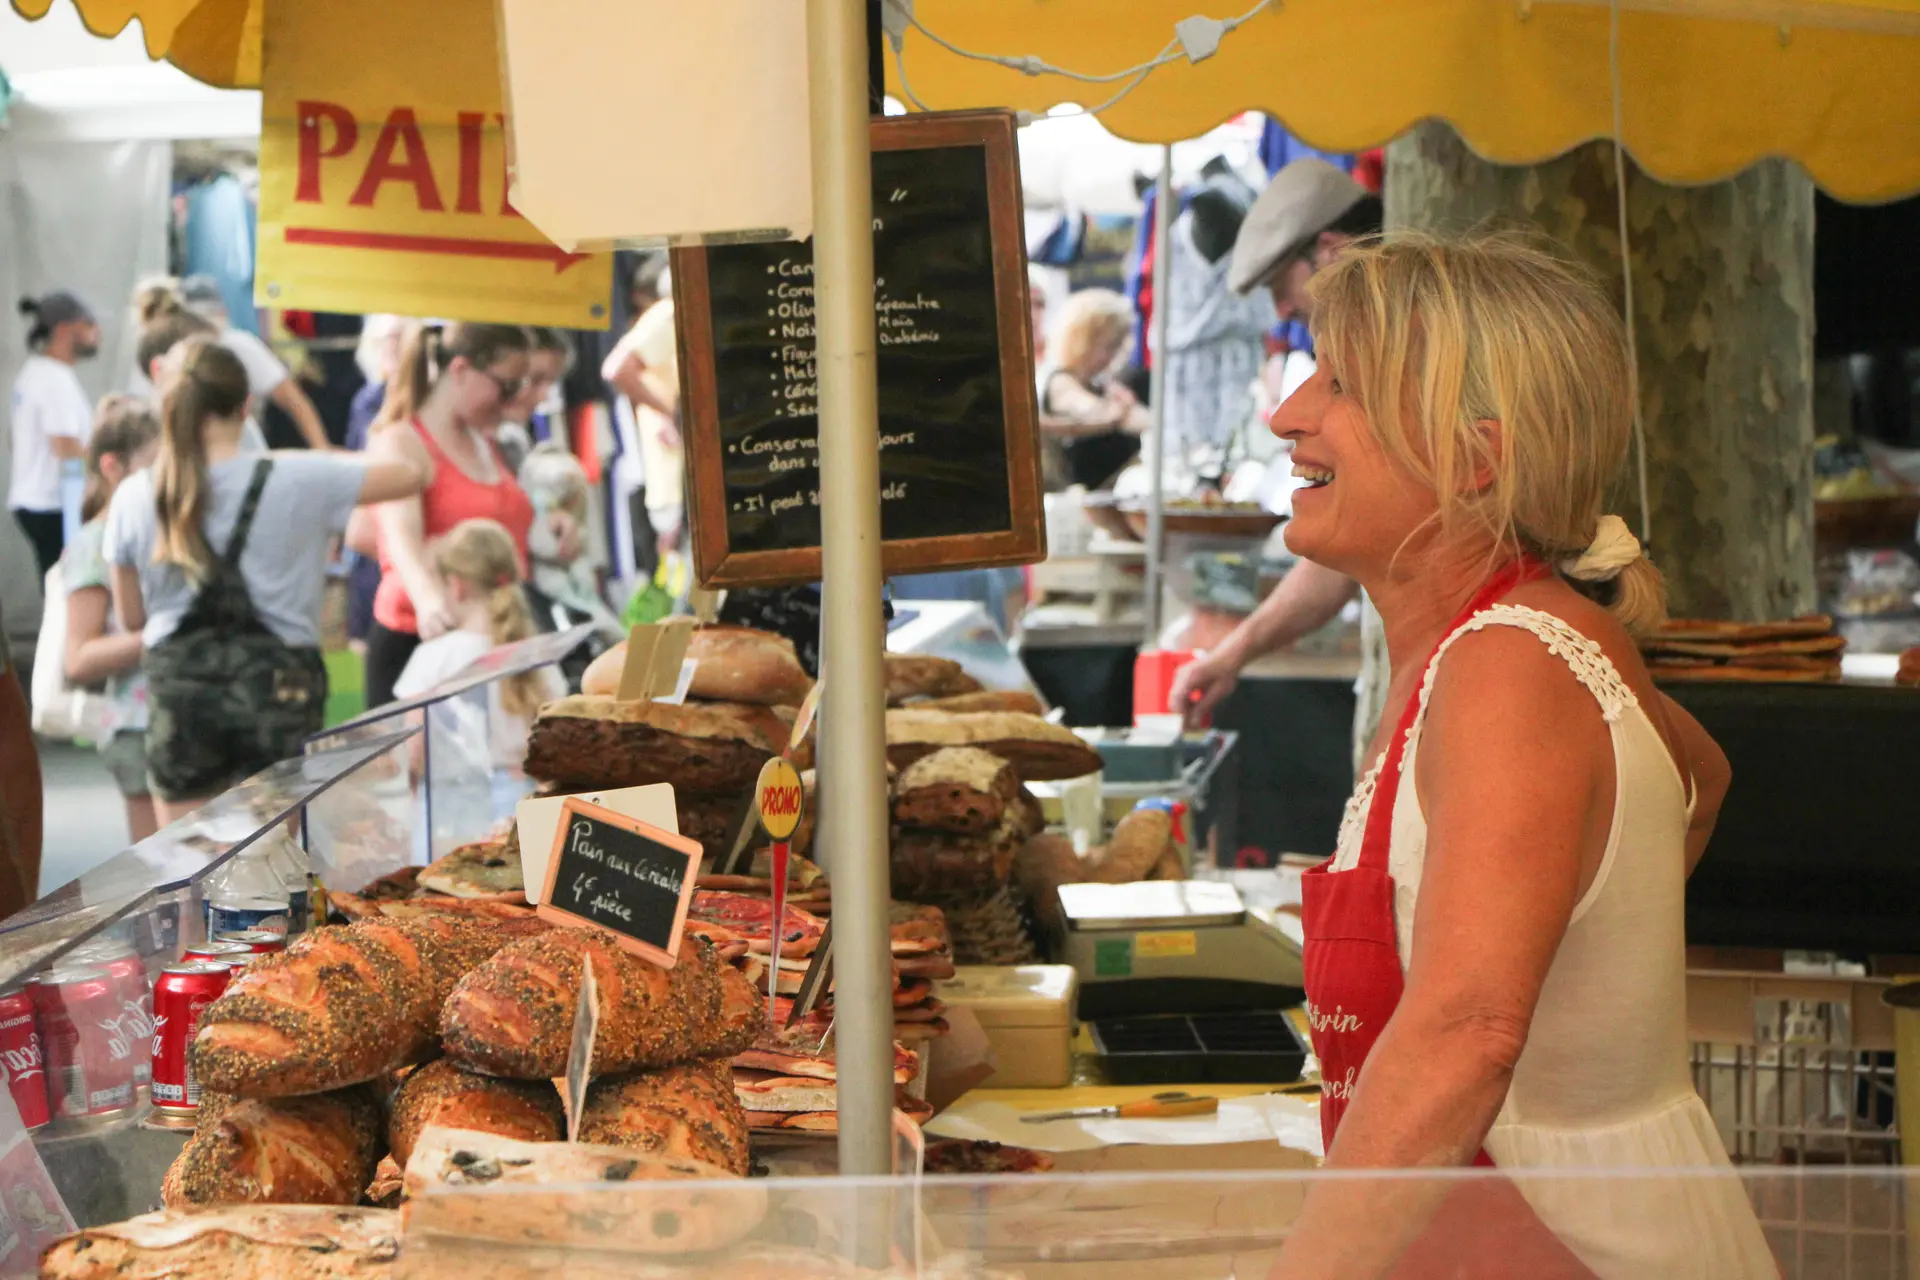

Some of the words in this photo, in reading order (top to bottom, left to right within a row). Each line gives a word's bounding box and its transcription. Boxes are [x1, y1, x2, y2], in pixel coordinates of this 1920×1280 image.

[741, 435, 820, 455] Conserva
[769, 454, 805, 472] dans
[762, 786, 800, 816] PROMO
[572, 821, 604, 862] Pain
[590, 889, 632, 921] pièce
